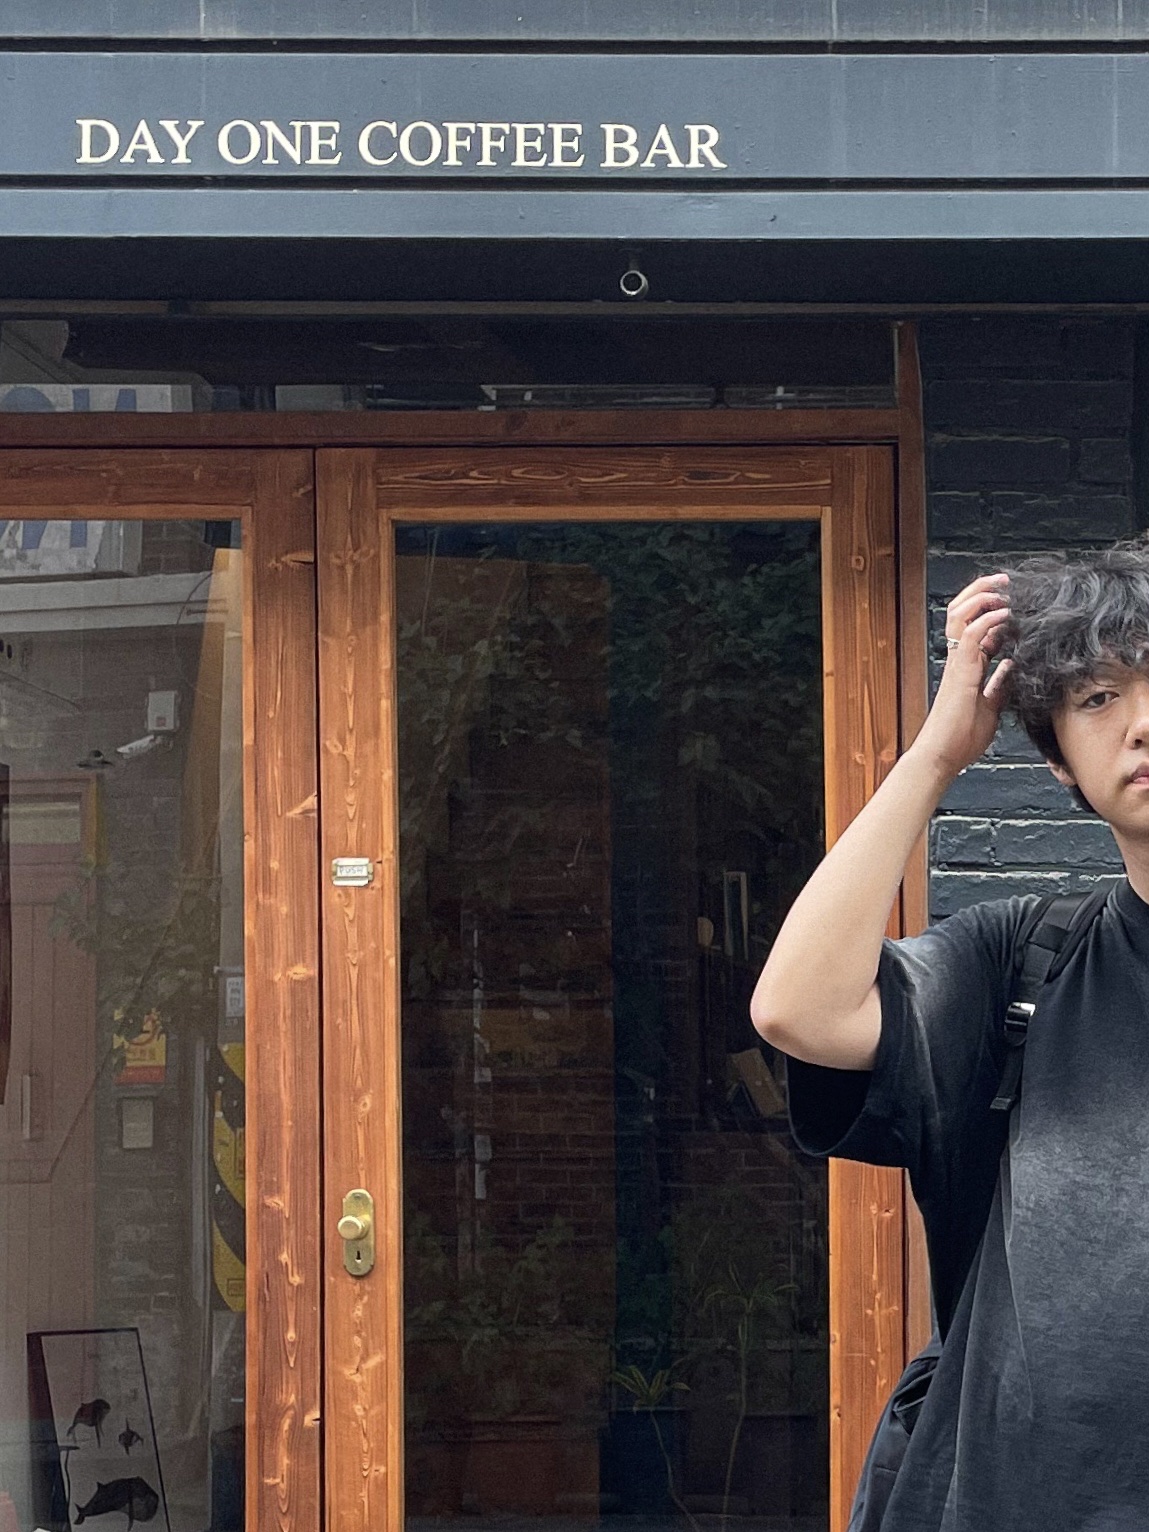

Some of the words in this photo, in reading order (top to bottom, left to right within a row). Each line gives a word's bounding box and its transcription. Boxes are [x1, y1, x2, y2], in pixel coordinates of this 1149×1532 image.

[75, 119, 205, 164] DAY
[217, 119, 342, 166] ONE
[358, 120, 585, 168] COFFEE
[599, 123, 728, 169] BAR
[340, 866, 364, 875] PUSH
